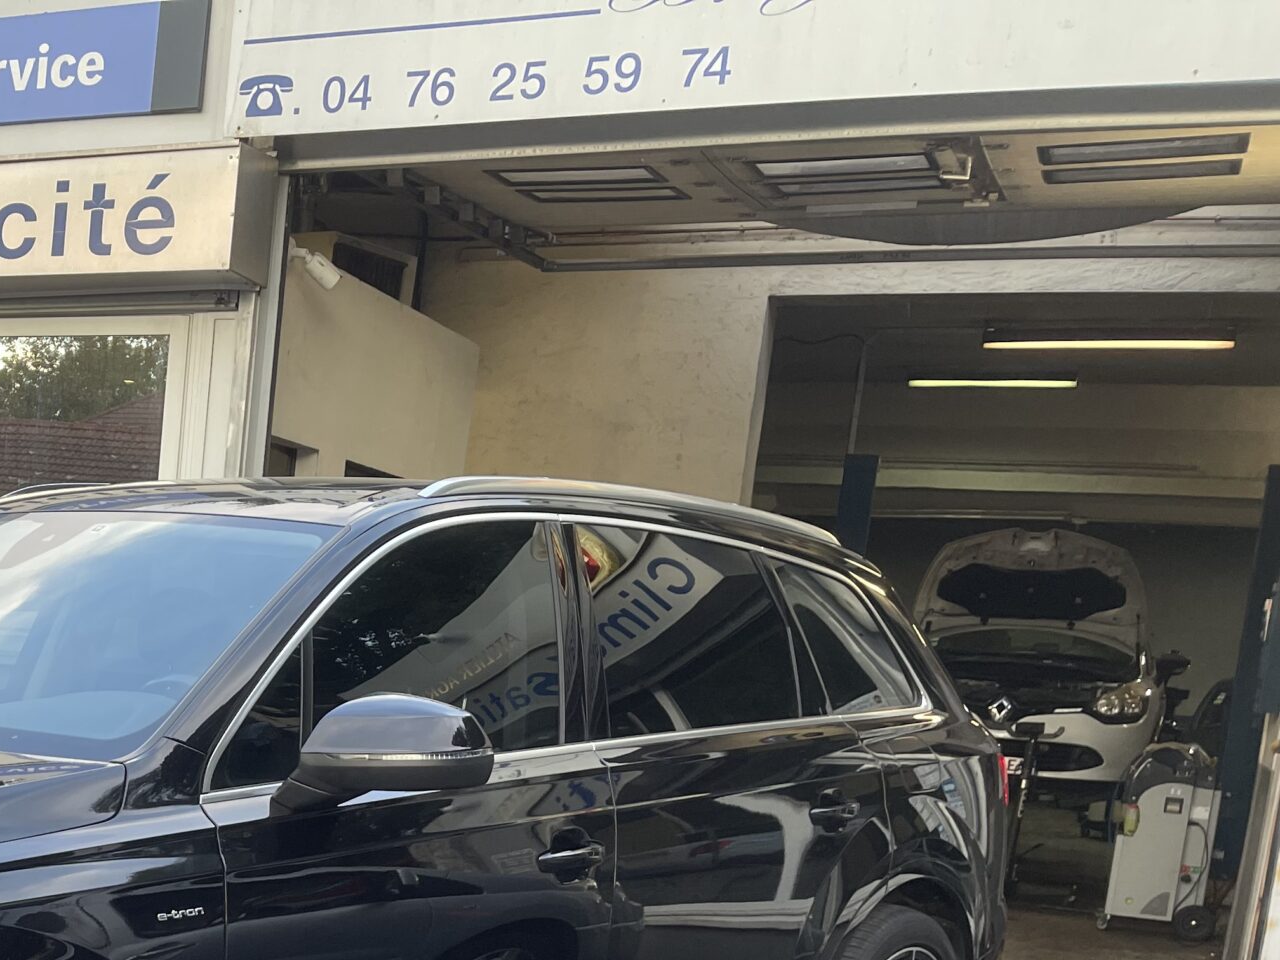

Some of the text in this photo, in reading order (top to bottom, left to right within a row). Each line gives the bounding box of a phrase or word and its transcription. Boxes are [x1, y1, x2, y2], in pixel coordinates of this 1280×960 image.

[321, 45, 732, 114] 04 76 25 59 74
[157, 907, 204, 921] e-tron
